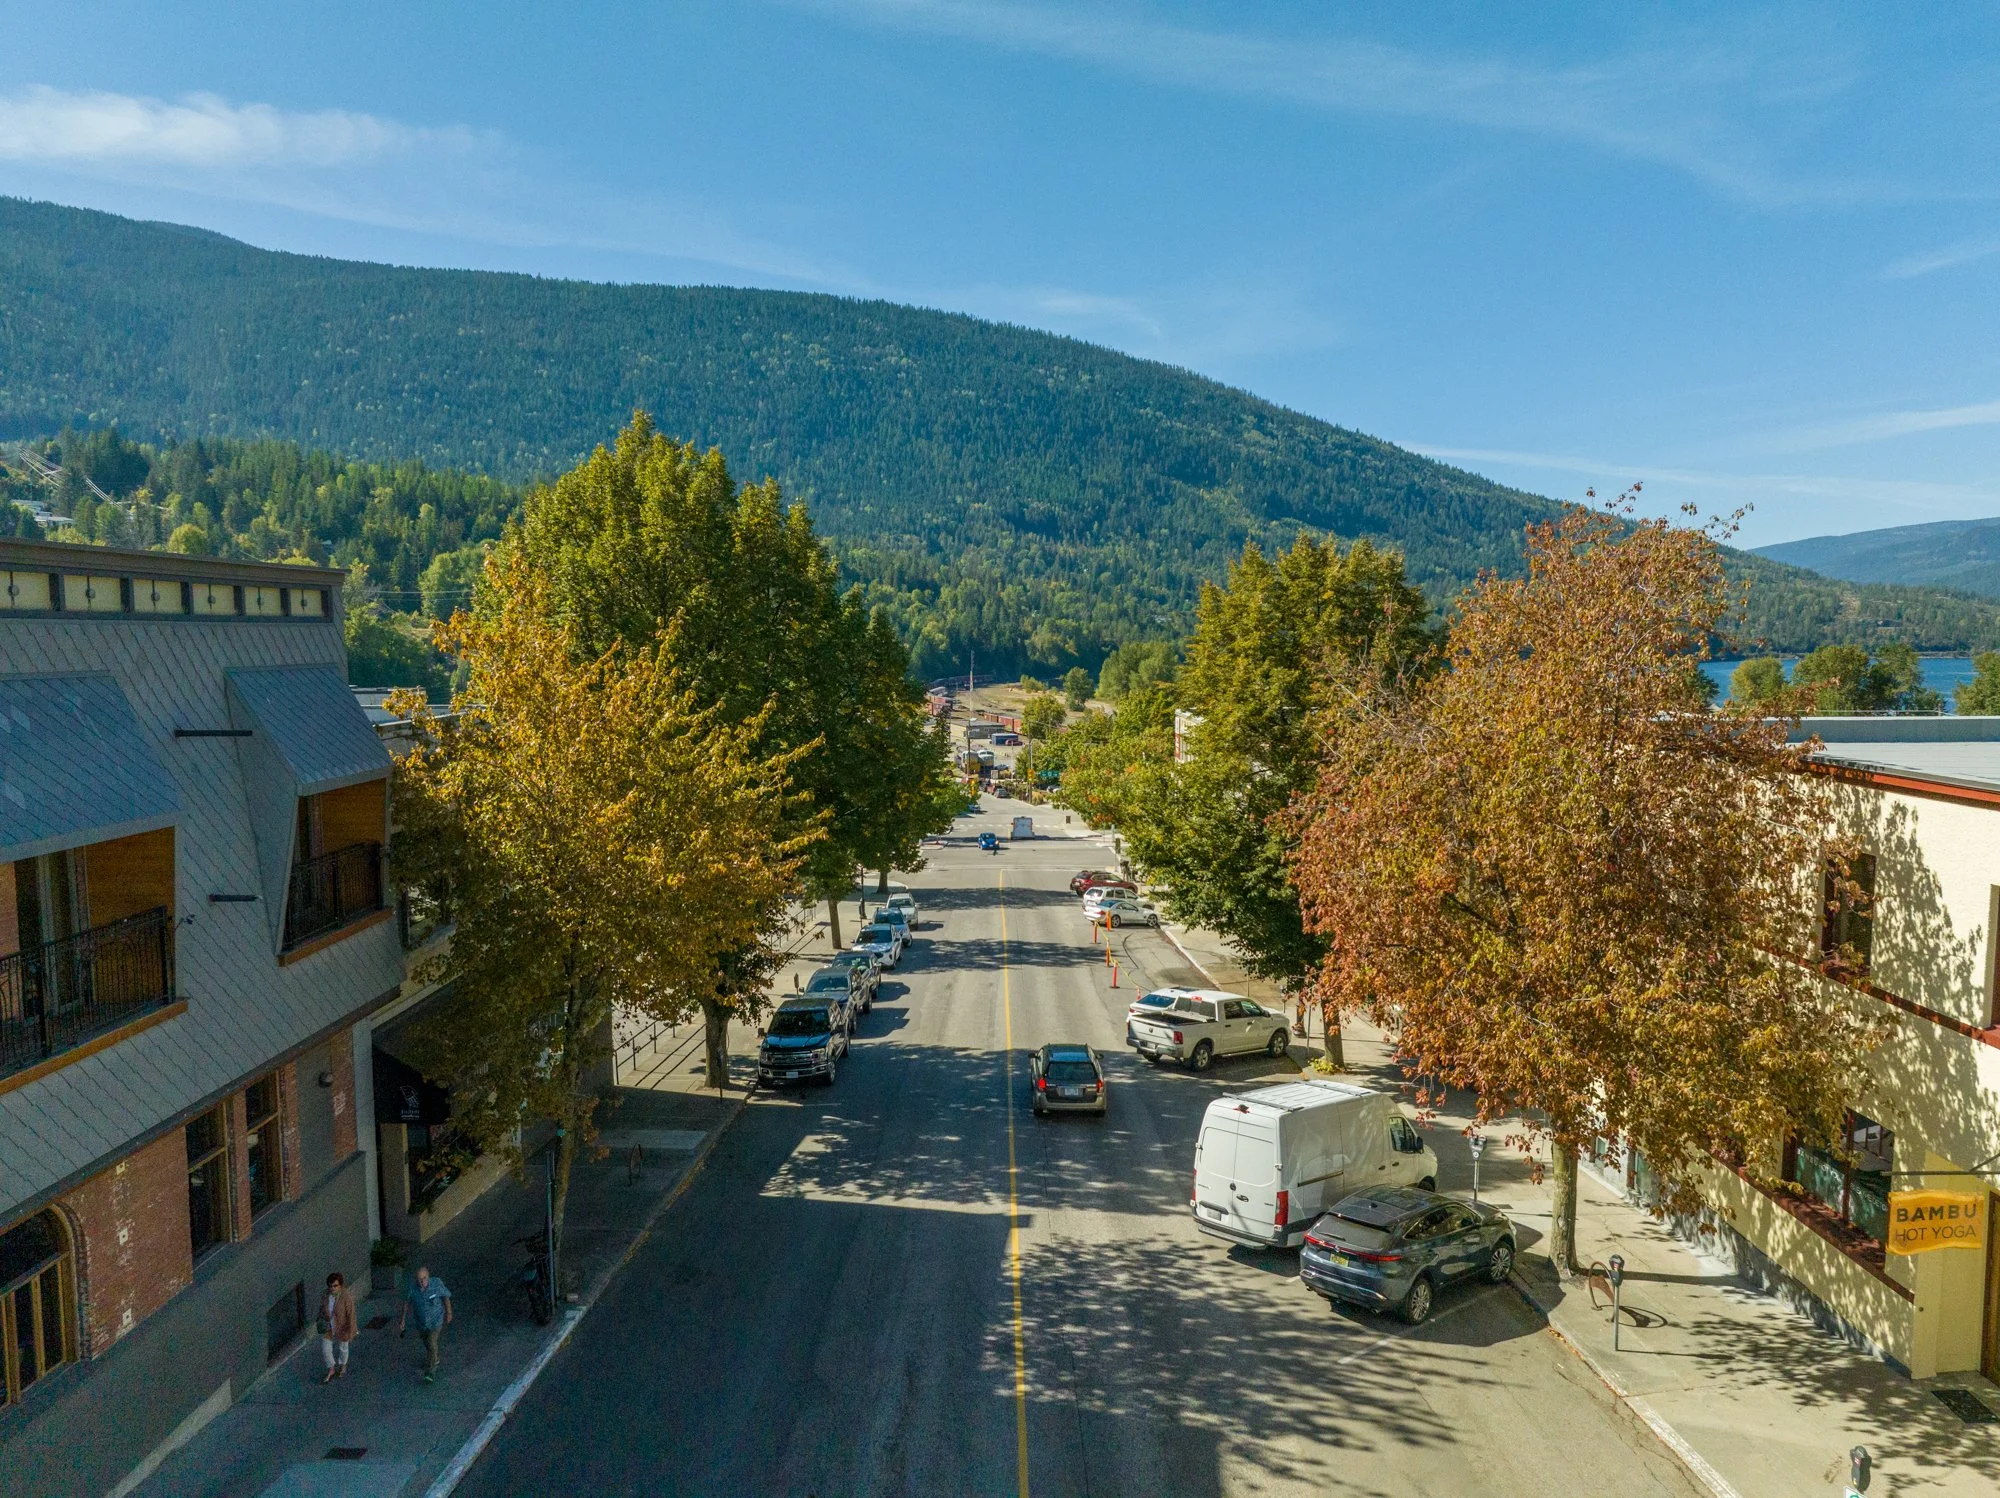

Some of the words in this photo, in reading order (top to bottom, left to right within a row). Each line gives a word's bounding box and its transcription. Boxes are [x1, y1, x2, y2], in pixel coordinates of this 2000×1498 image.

[1896, 1204, 1976, 1222] BAMBU
[1896, 1227, 1927, 1241] HOT
[1932, 1225, 1976, 1239] YOGA
